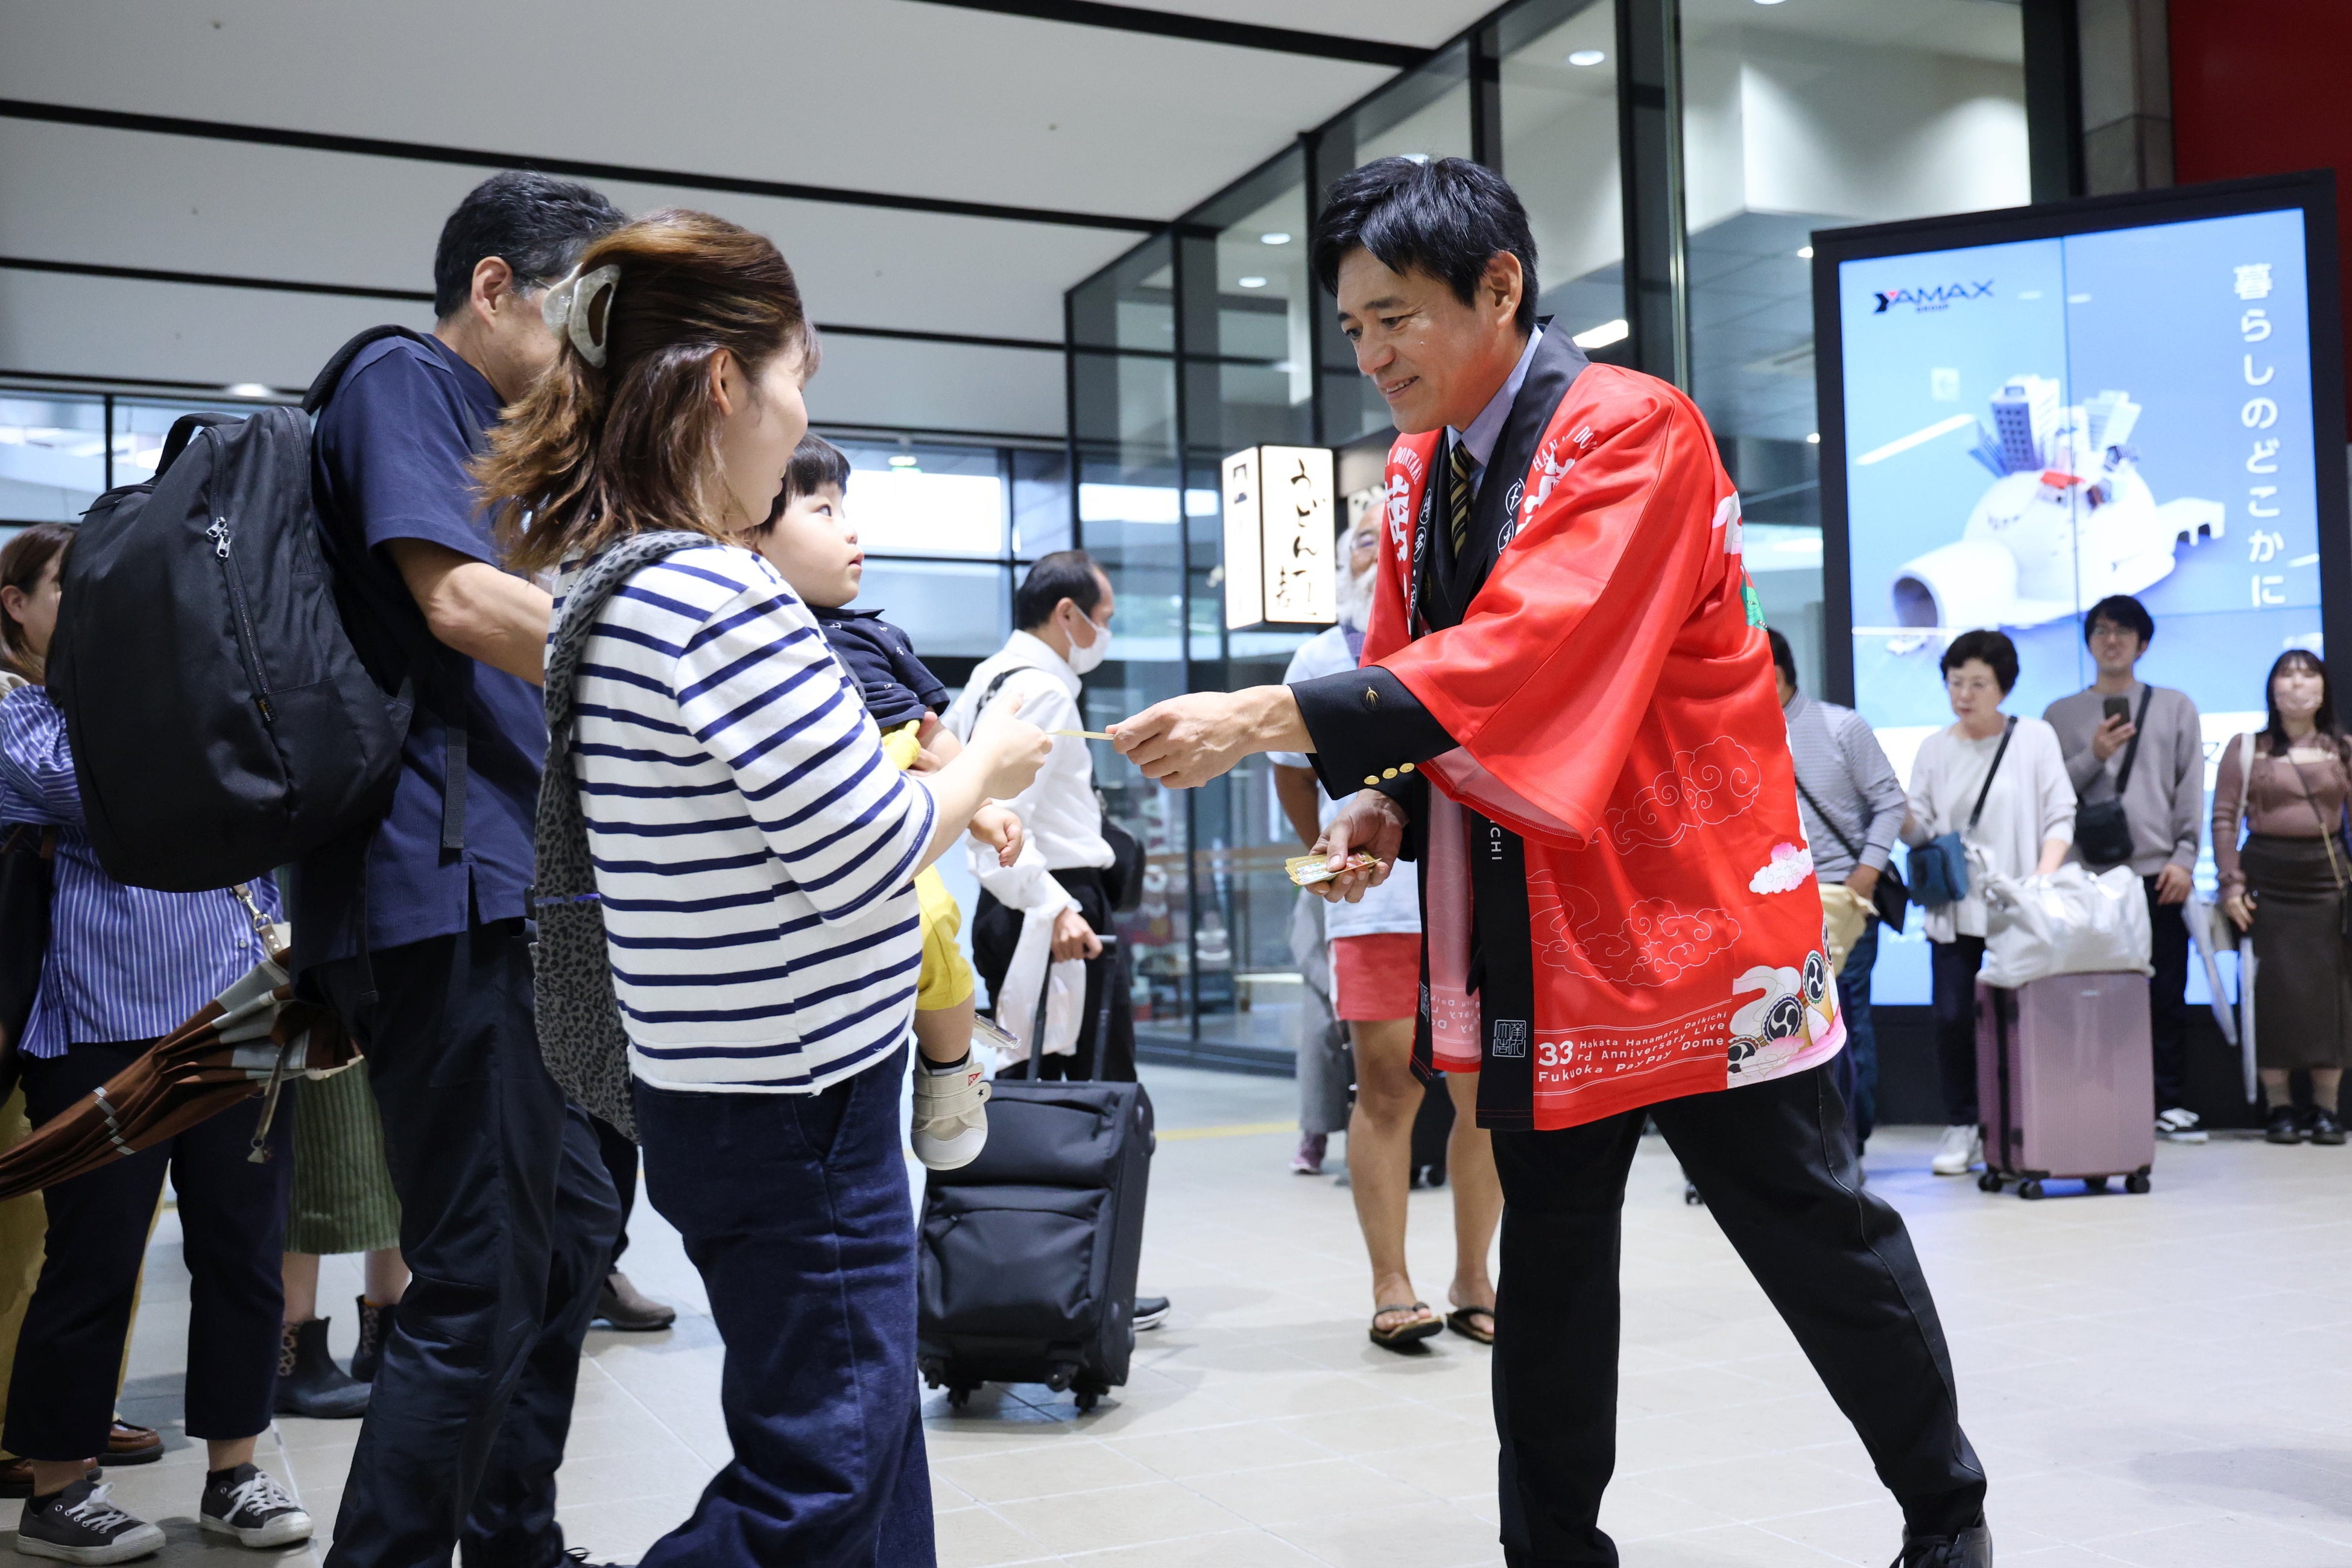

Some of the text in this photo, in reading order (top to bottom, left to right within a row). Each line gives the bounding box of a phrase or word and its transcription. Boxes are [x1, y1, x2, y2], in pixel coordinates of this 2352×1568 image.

[2233, 262, 2288, 608] 暮らしのどこかに
[1538, 1023, 1725, 1067] 33 rd Anniversary Live
[1579, 1011, 1727, 1049] Hakata Hanamaru Daikichi
[1538, 1037, 1724, 1083] Fukuoka PayPay Dome
